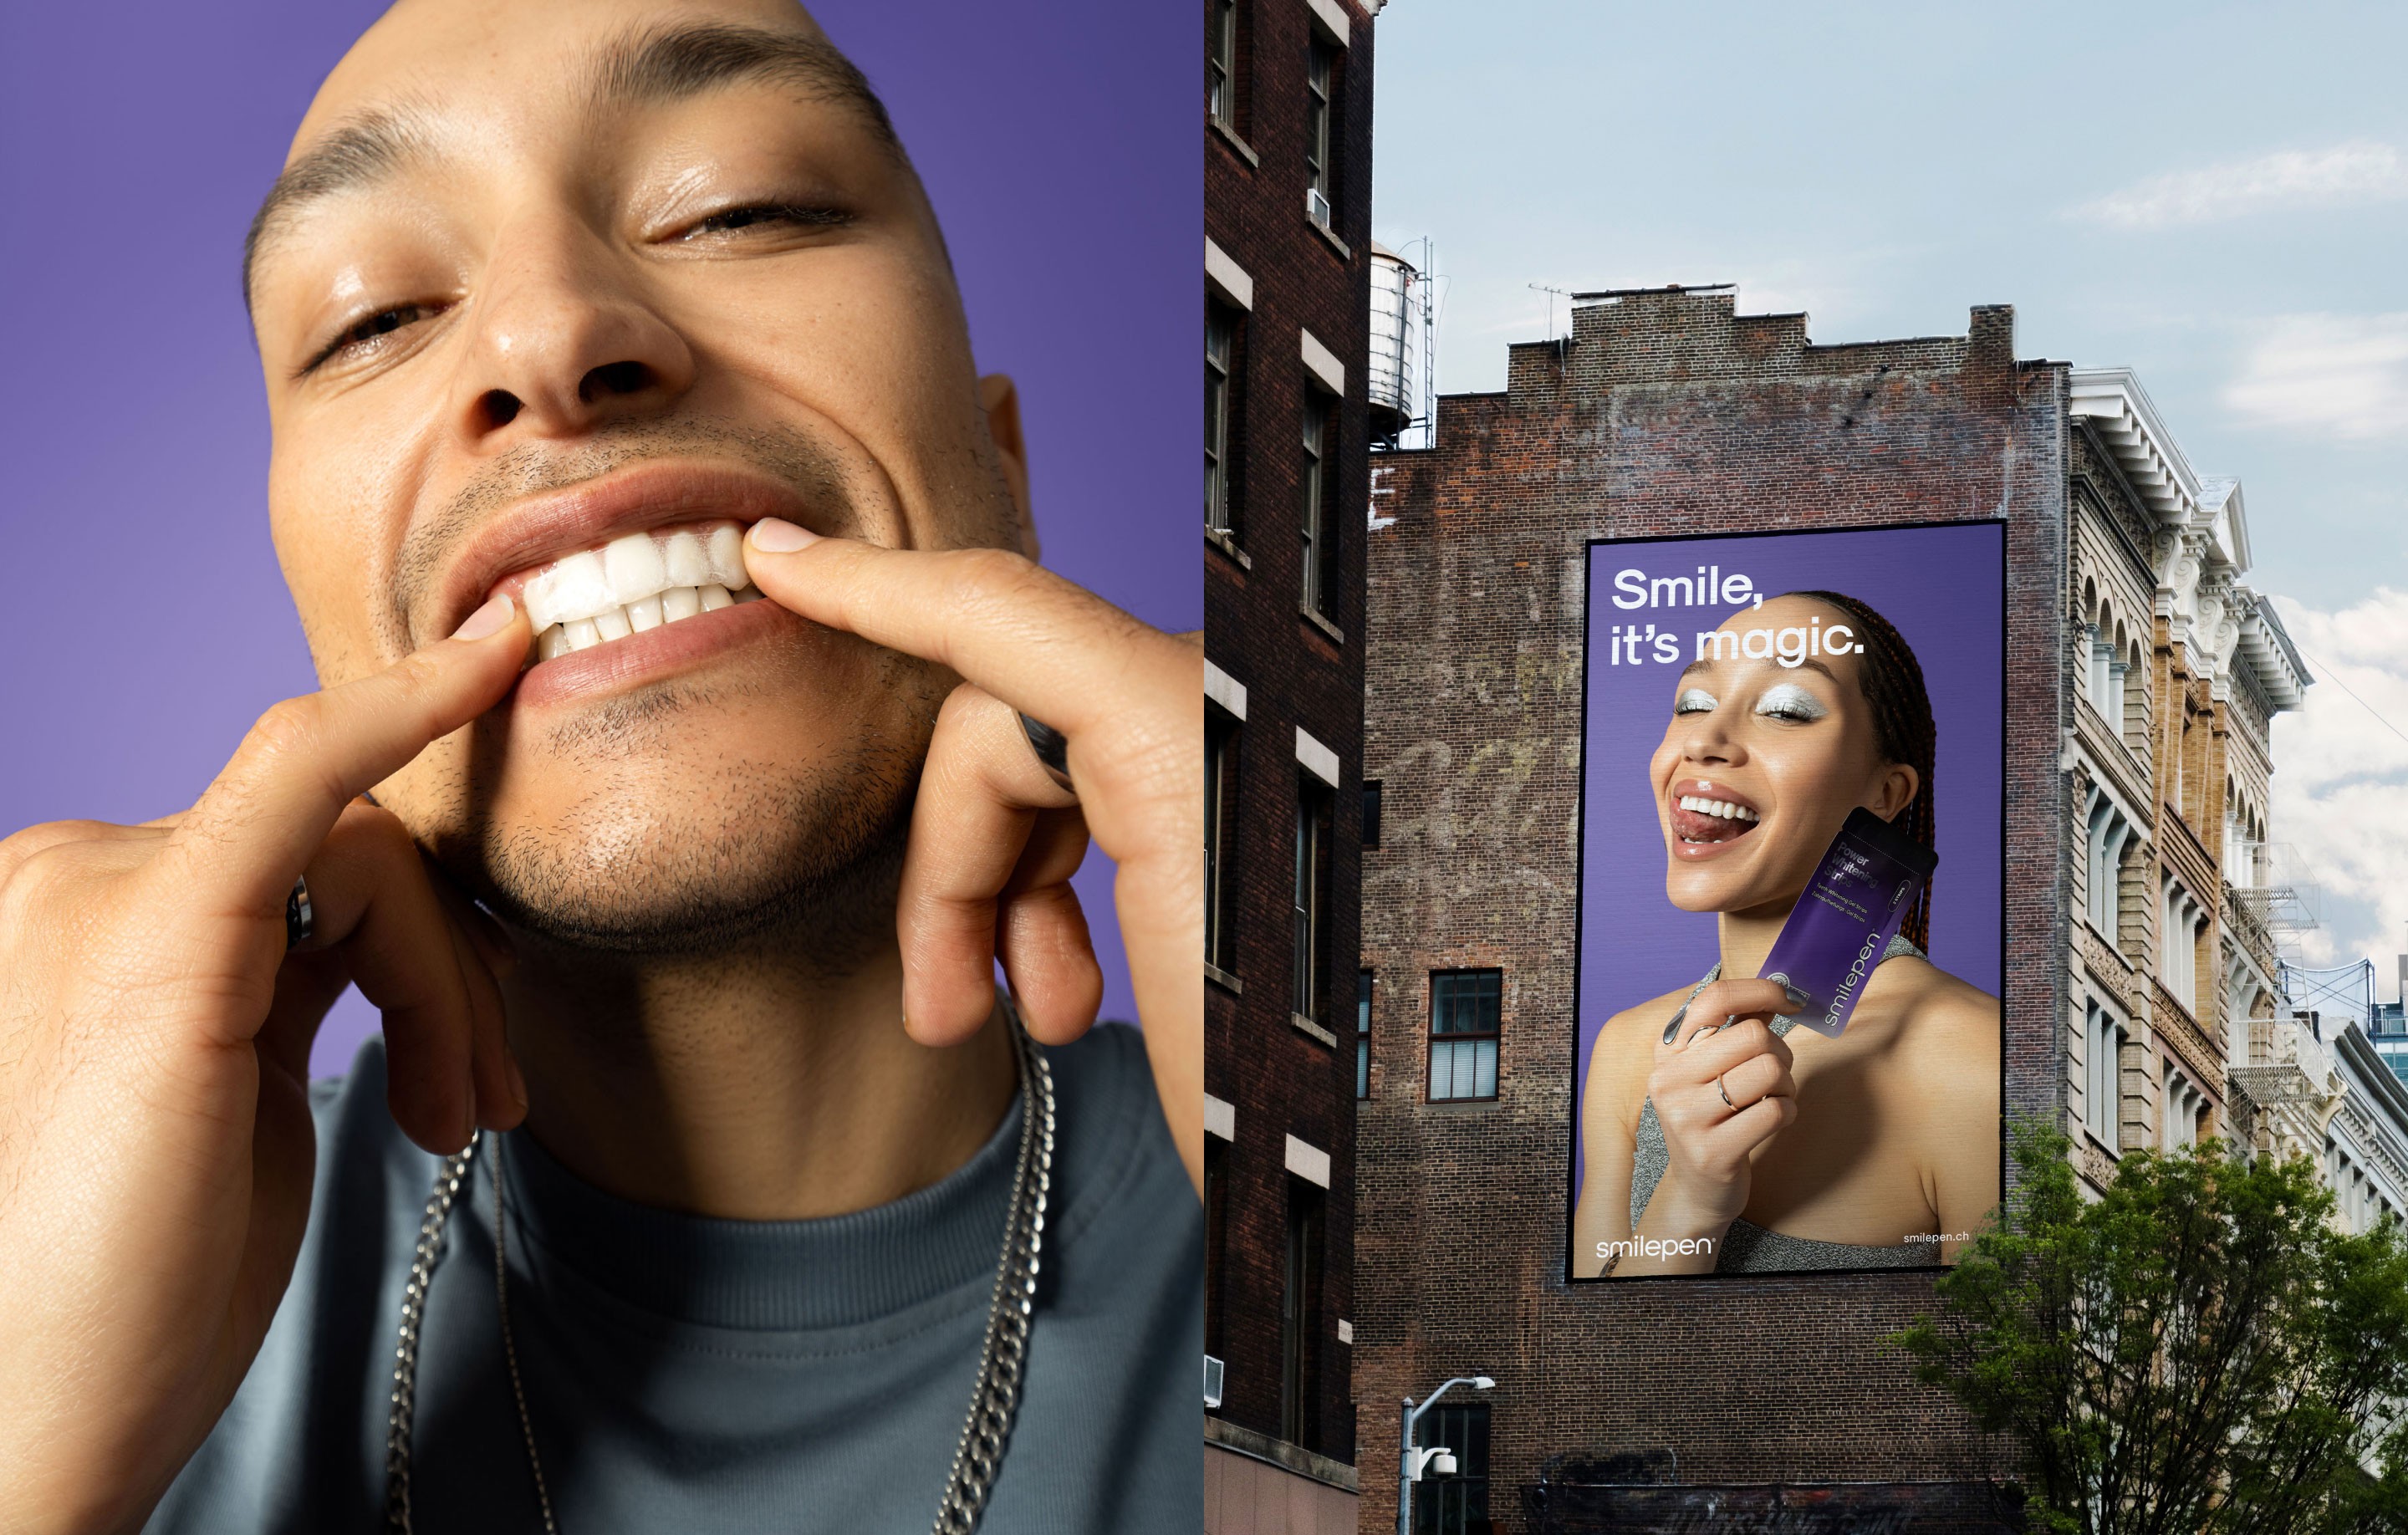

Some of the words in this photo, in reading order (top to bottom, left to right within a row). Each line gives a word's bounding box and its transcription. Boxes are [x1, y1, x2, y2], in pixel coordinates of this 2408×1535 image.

[1611, 565, 1763, 611] Smile,
[1696, 616, 1865, 668] magic.
[1838, 841, 1870, 866] Power
[1824, 865, 1854, 888] Strips
[1831, 853, 1880, 889] Whitening
[1903, 1231, 1969, 1244] smilepen.ch
